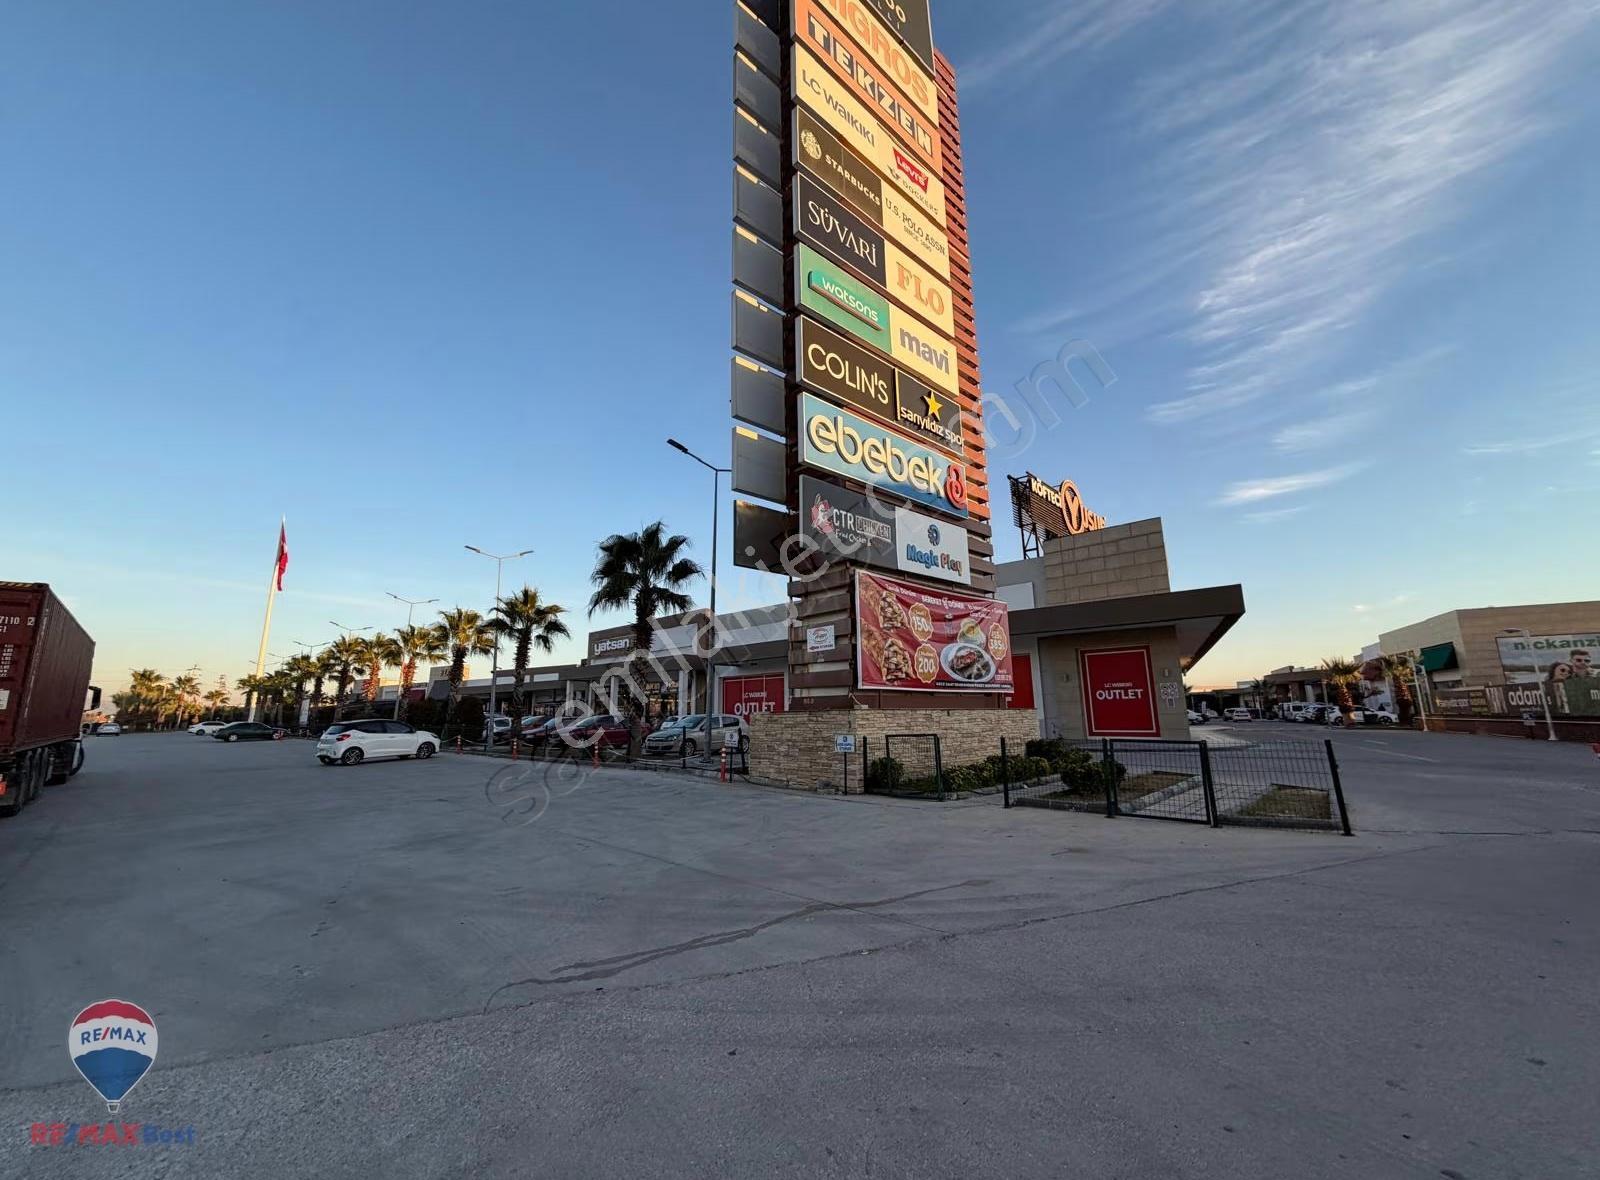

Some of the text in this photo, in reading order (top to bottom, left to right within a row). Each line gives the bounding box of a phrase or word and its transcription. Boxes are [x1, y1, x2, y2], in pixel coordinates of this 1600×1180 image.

[829, 0, 928, 105] IGROS
[802, 69, 821, 96] LC
[808, 12, 932, 157] TEKZEN
[825, 154, 881, 206] STARBUCKS
[902, 212, 924, 238] POLO
[822, 277, 879, 322] watsons
[896, 261, 945, 316] FLO
[808, 343, 888, 405] COLIN'S
[900, 327, 950, 375] mavi
[807, 414, 945, 498] ebebek
[833, 508, 891, 541] CTR CHICKEN
[906, 543, 962, 576] Magic Play
[1096, 688, 1144, 700] OUTLET
